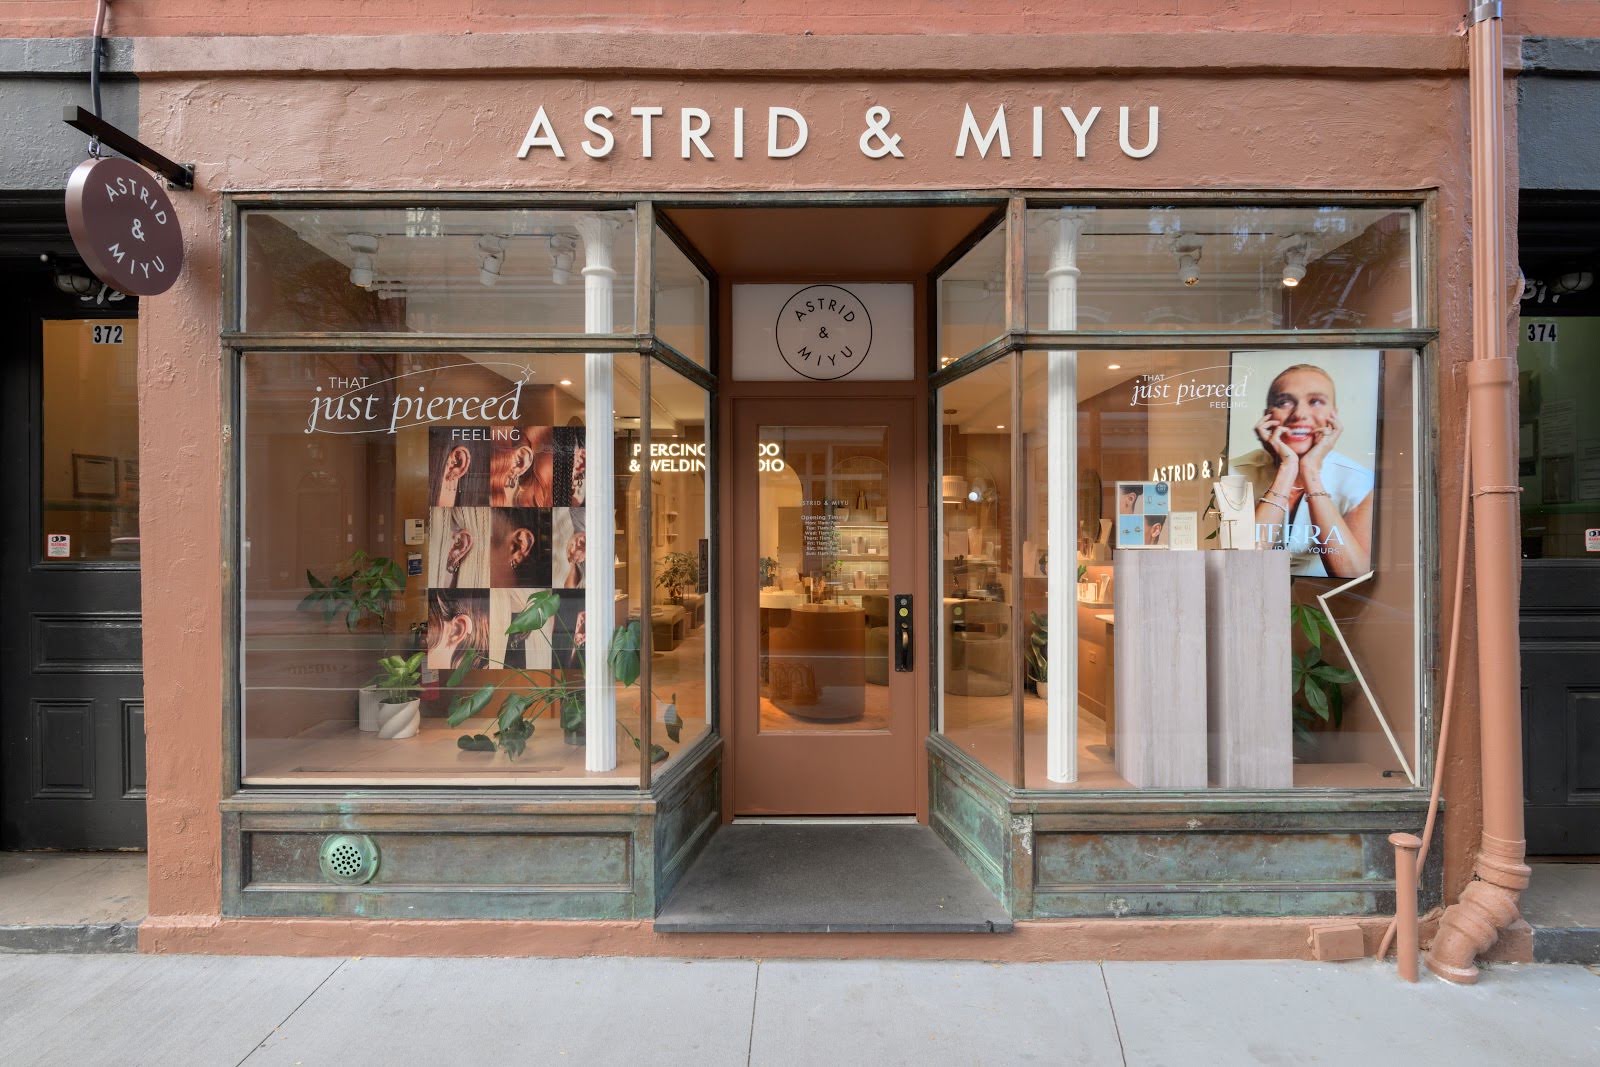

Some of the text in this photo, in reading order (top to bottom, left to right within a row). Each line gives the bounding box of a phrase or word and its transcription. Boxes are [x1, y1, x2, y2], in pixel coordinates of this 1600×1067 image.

[516, 102, 1159, 159] ASTRID & MIYU
[105, 176, 167, 225] ASTRID
[131, 218, 145, 242] &
[108, 243, 165, 279] MIYU
[795, 298, 855, 322] ASTRID
[94, 325, 123, 344] 372
[819, 326, 829, 339] &
[1528, 324, 1556, 341] 374
[798, 346, 853, 366] MIYU
[328, 376, 369, 389] THAT
[1142, 374, 1165, 382] THAT
[1130, 375, 1248, 406] just pierced
[304, 379, 523, 434] just pierced
[1209, 401, 1248, 409] FEELING
[451, 429, 521, 441] FEELING
[629, 458, 640, 473] &
[650, 458, 706, 473] WELDIN
[1152, 462, 1196, 482] ASTRID
[1202, 459, 1211, 479] &
[1308, 547, 1340, 555] YOURS
